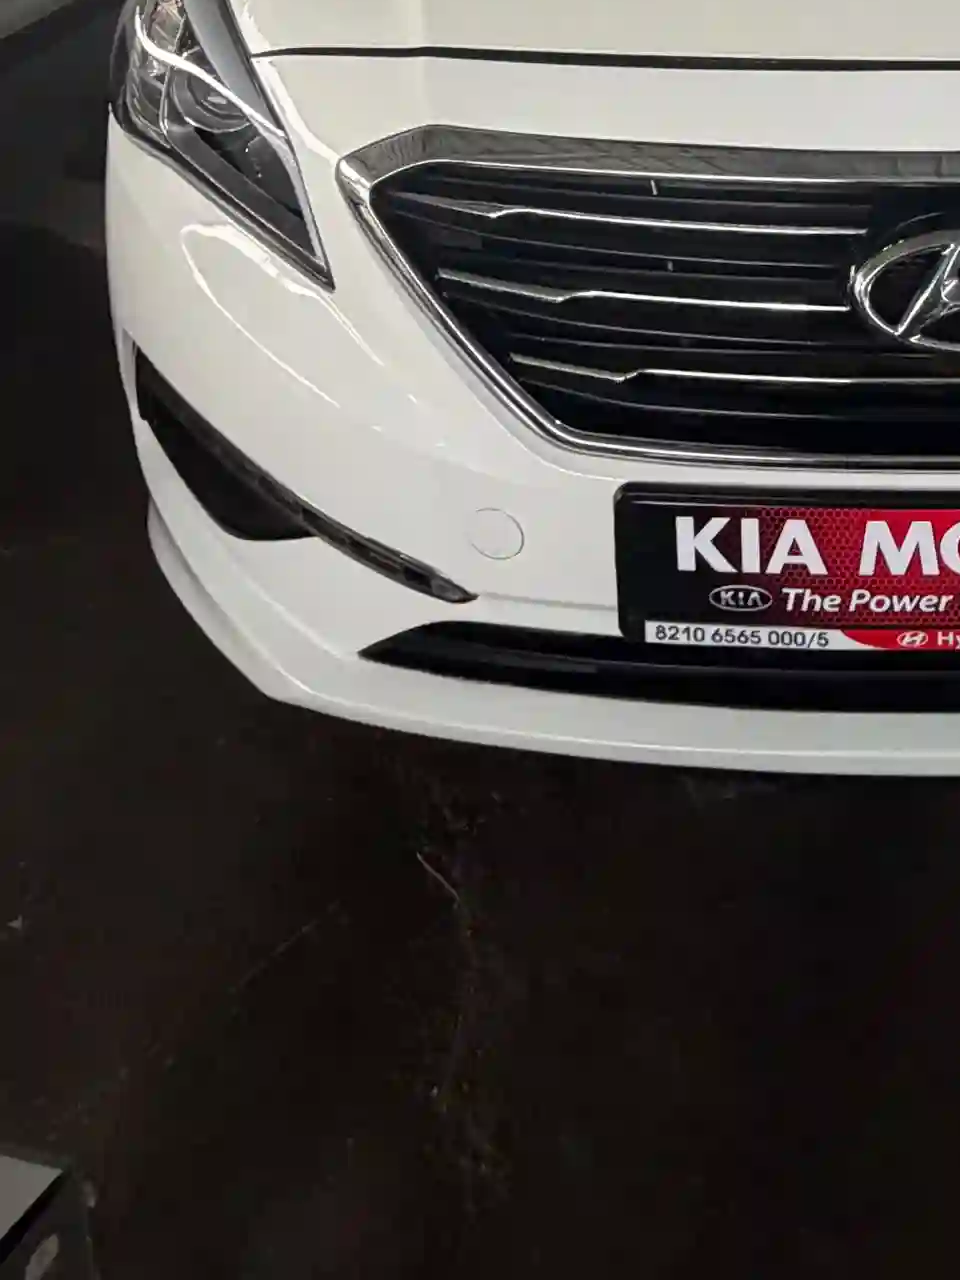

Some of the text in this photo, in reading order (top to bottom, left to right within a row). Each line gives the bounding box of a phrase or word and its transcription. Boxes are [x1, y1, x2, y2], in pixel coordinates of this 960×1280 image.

[675, 515, 828, 576] KIA
[781, 587, 840, 612] The
[849, 588, 953, 613] Power
[655, 625, 829, 648] 8210 6565 000/5
